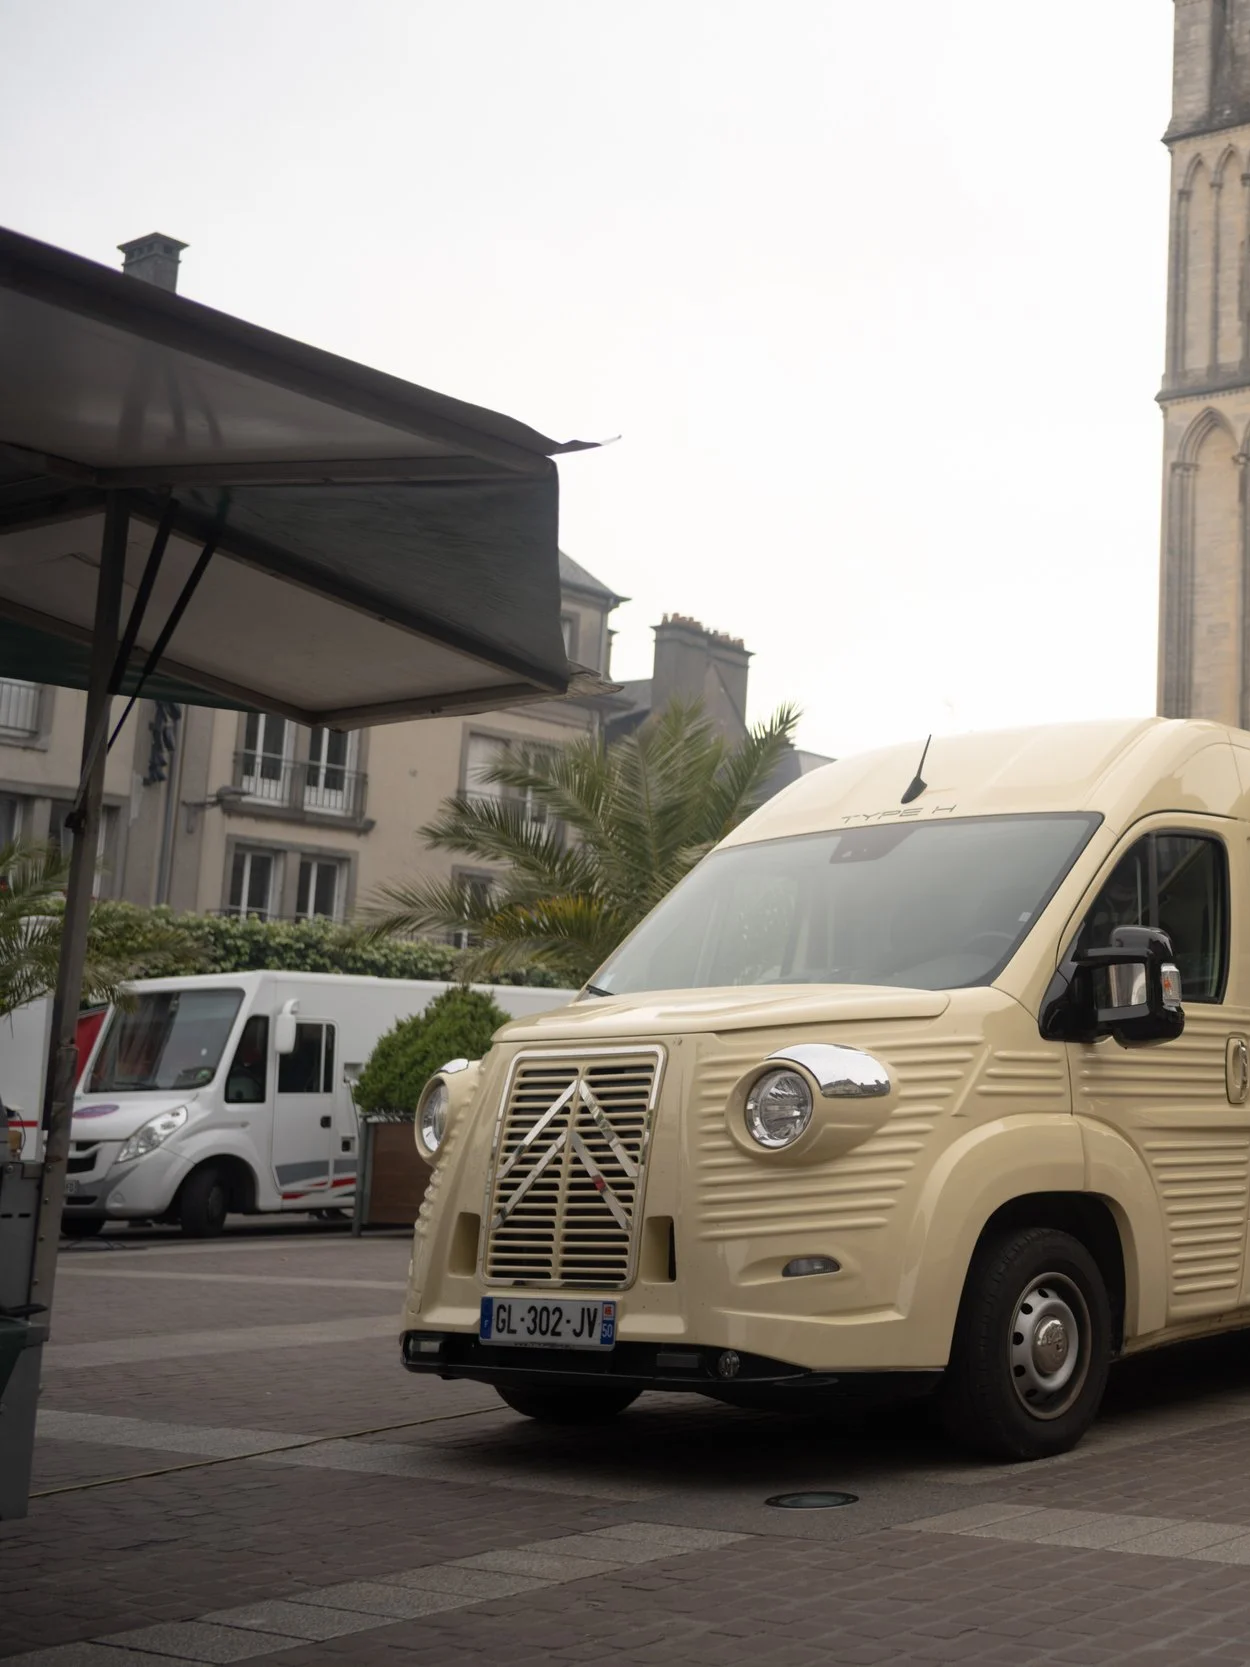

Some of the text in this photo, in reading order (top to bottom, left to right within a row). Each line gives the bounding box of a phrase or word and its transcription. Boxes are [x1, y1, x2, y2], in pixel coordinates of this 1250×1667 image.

[841, 804, 957, 824] TYPE H
[602, 1323, 613, 1338] 50
